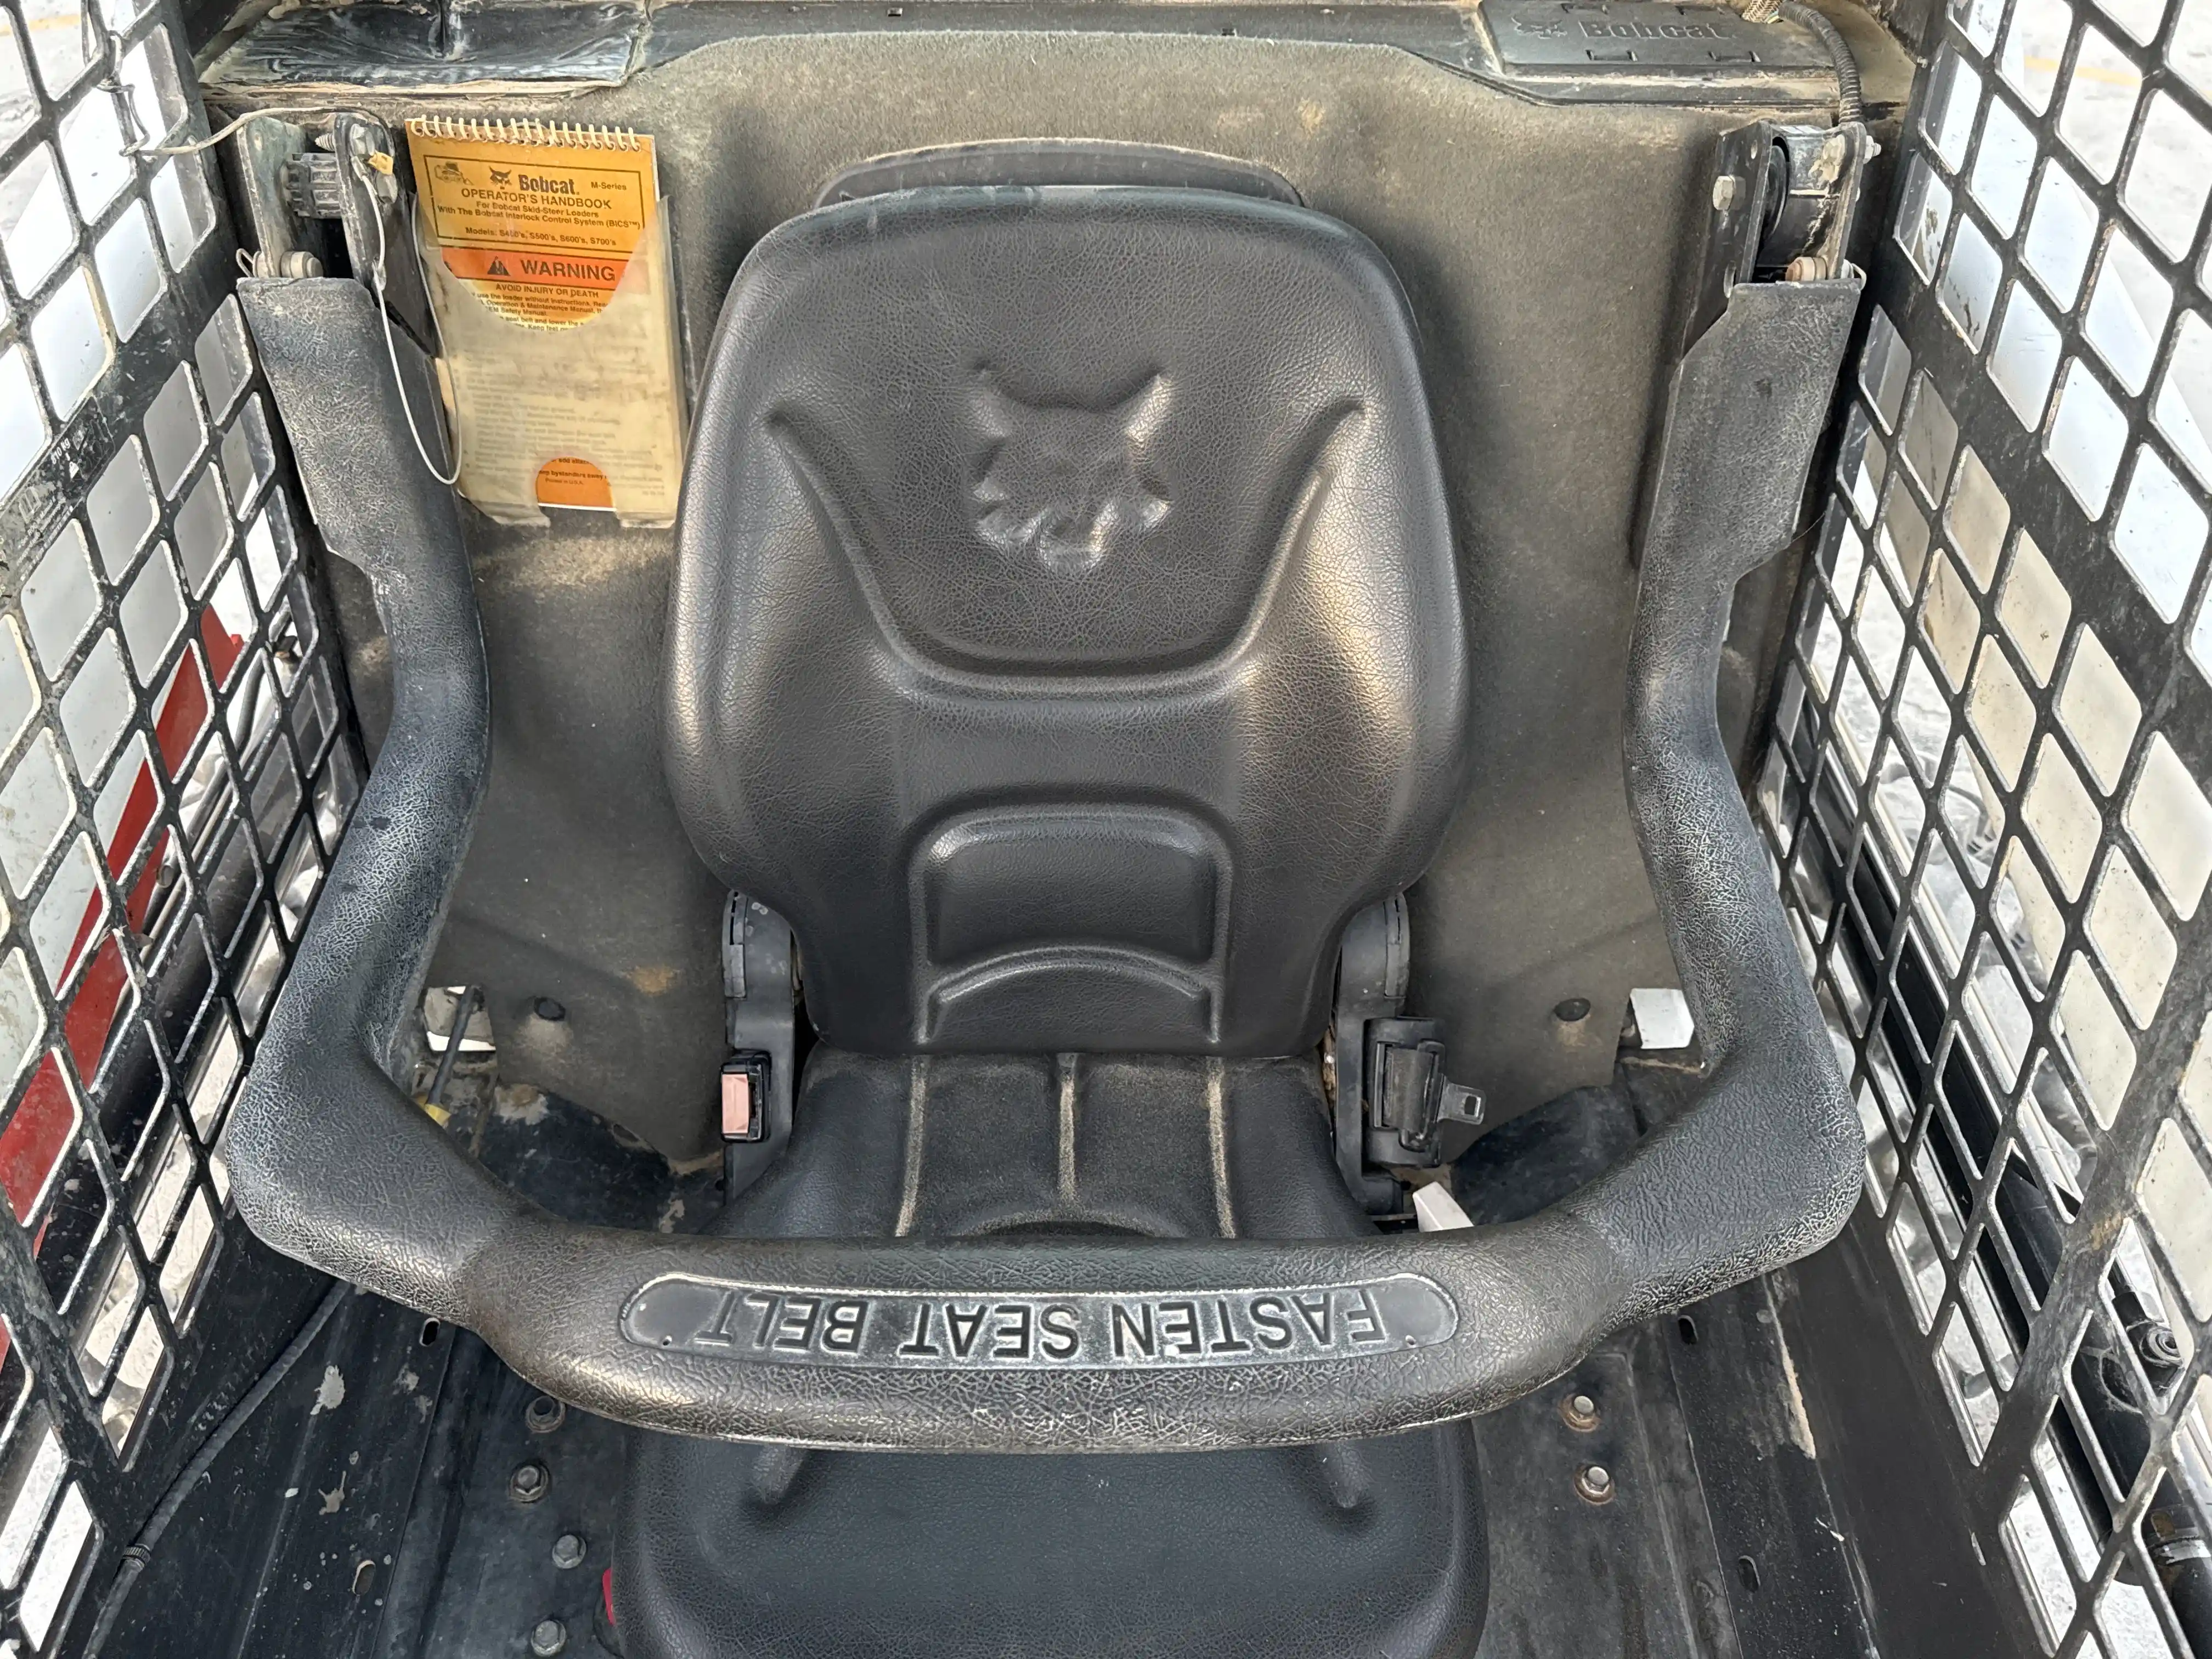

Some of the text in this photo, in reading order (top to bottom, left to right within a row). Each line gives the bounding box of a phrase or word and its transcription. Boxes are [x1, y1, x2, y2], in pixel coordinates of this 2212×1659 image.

[1577, 20, 1730, 40] Bobcat
[518, 174, 575, 195] Bobcat
[590, 181, 627, 191] M-Series
[461, 188, 612, 210] OPERATOR'S HANDBOOK
[437, 205, 455, 214] With
[457, 207, 473, 216] The
[475, 209, 503, 218] Bobcat
[505, 212, 540, 222] Interlock
[541, 215, 572, 224] Control
[573, 218, 604, 227] System
[476, 200, 599, 218] For Bobcat Skid-Steer Loaders
[590, 237, 616, 246] S700's
[520, 259, 616, 281] WARNING
[495, 283, 522, 292] AVOID
[524, 285, 554, 295] INJURY
[570, 289, 599, 298] DEATH
[486, 299, 518, 308] Operation
[527, 302, 568, 312] Maintenance
[551, 470, 586, 478] bystanders
[692, 1289, 1387, 1359] FASTEN SEAT BELT
